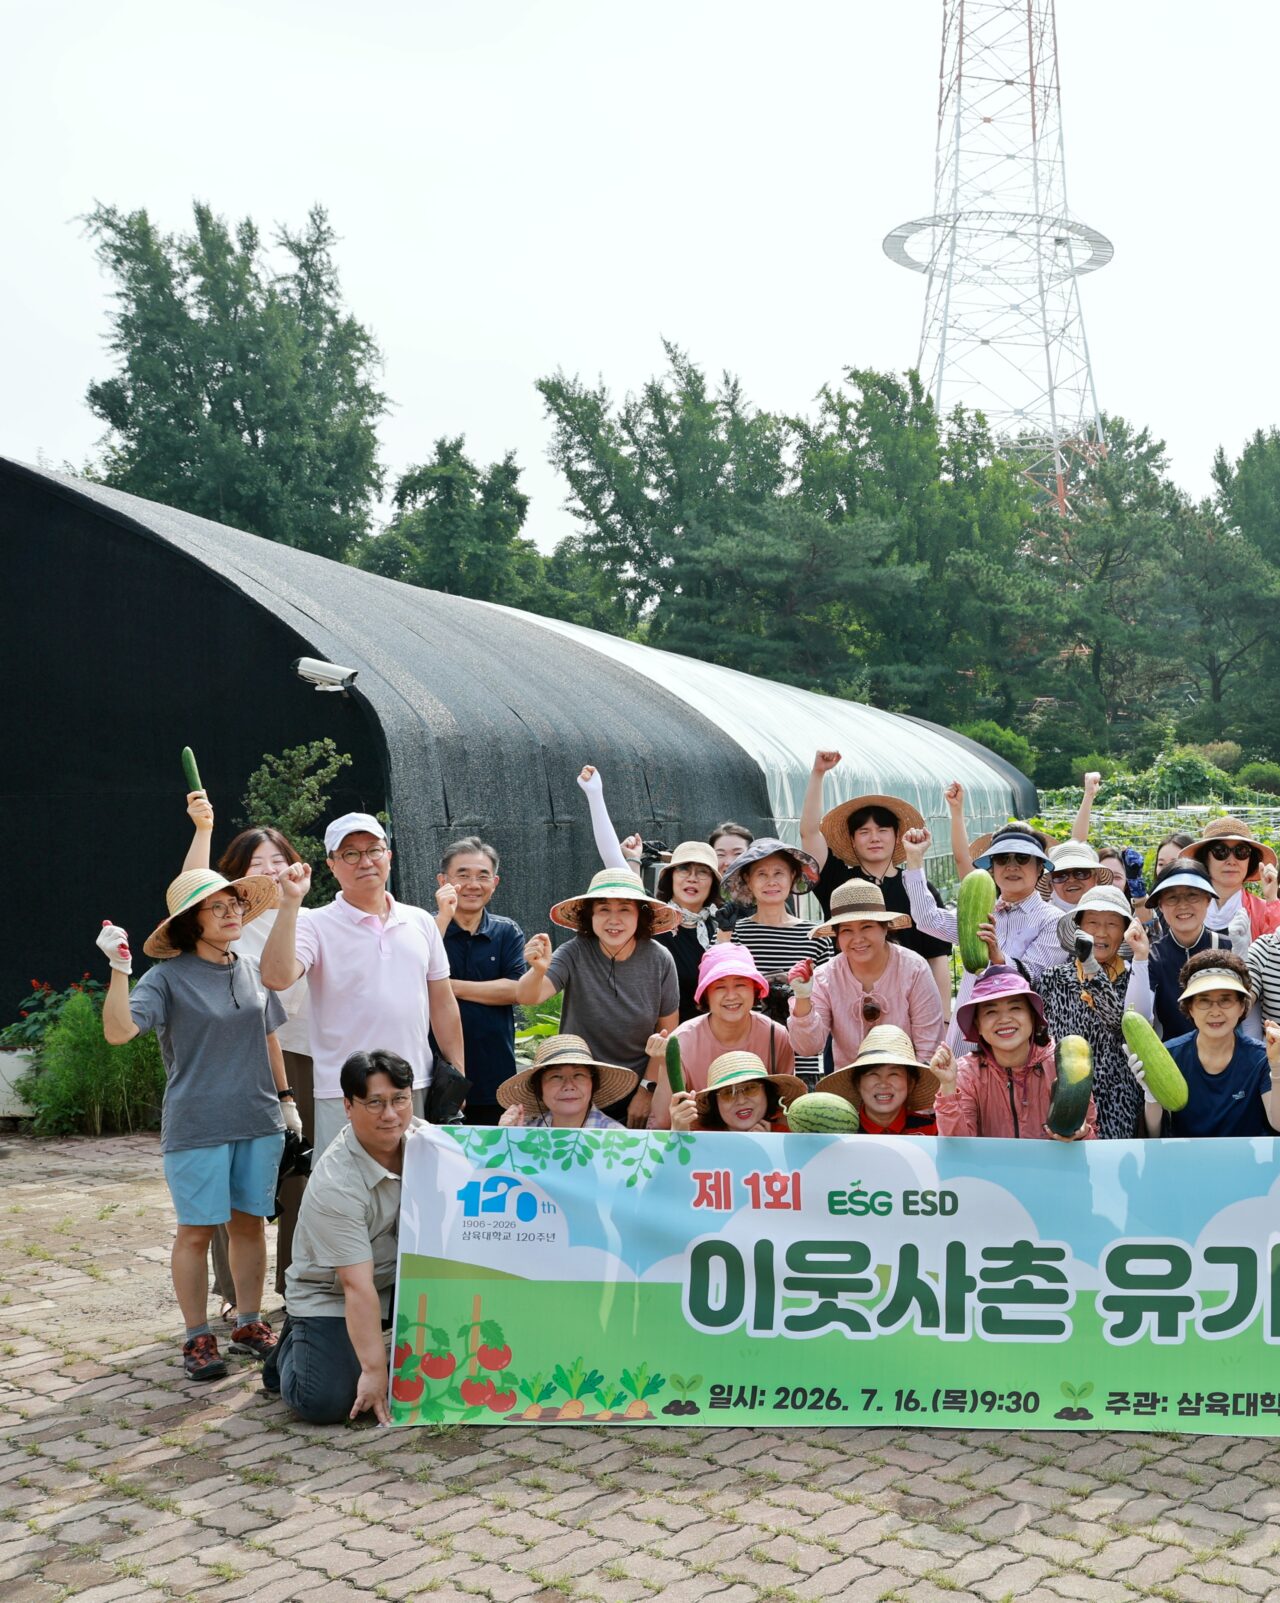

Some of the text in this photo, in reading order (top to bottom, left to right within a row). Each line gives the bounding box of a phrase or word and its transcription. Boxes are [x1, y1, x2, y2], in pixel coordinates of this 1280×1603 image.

[457, 1175, 557, 1222] 120 th
[692, 1171, 802, 1211] 제 1회
[828, 1190, 959, 1216] ESG ESD
[462, 1230, 556, 1243] 삼육대학교 120주년
[690, 1239, 1069, 1336] 이웃사촌
[708, 1384, 766, 1410] 일시:
[773, 1387, 849, 1411] 2026.
[861, 1388, 883, 1411] 7.
[1105, 1391, 1168, 1416] 주관:
